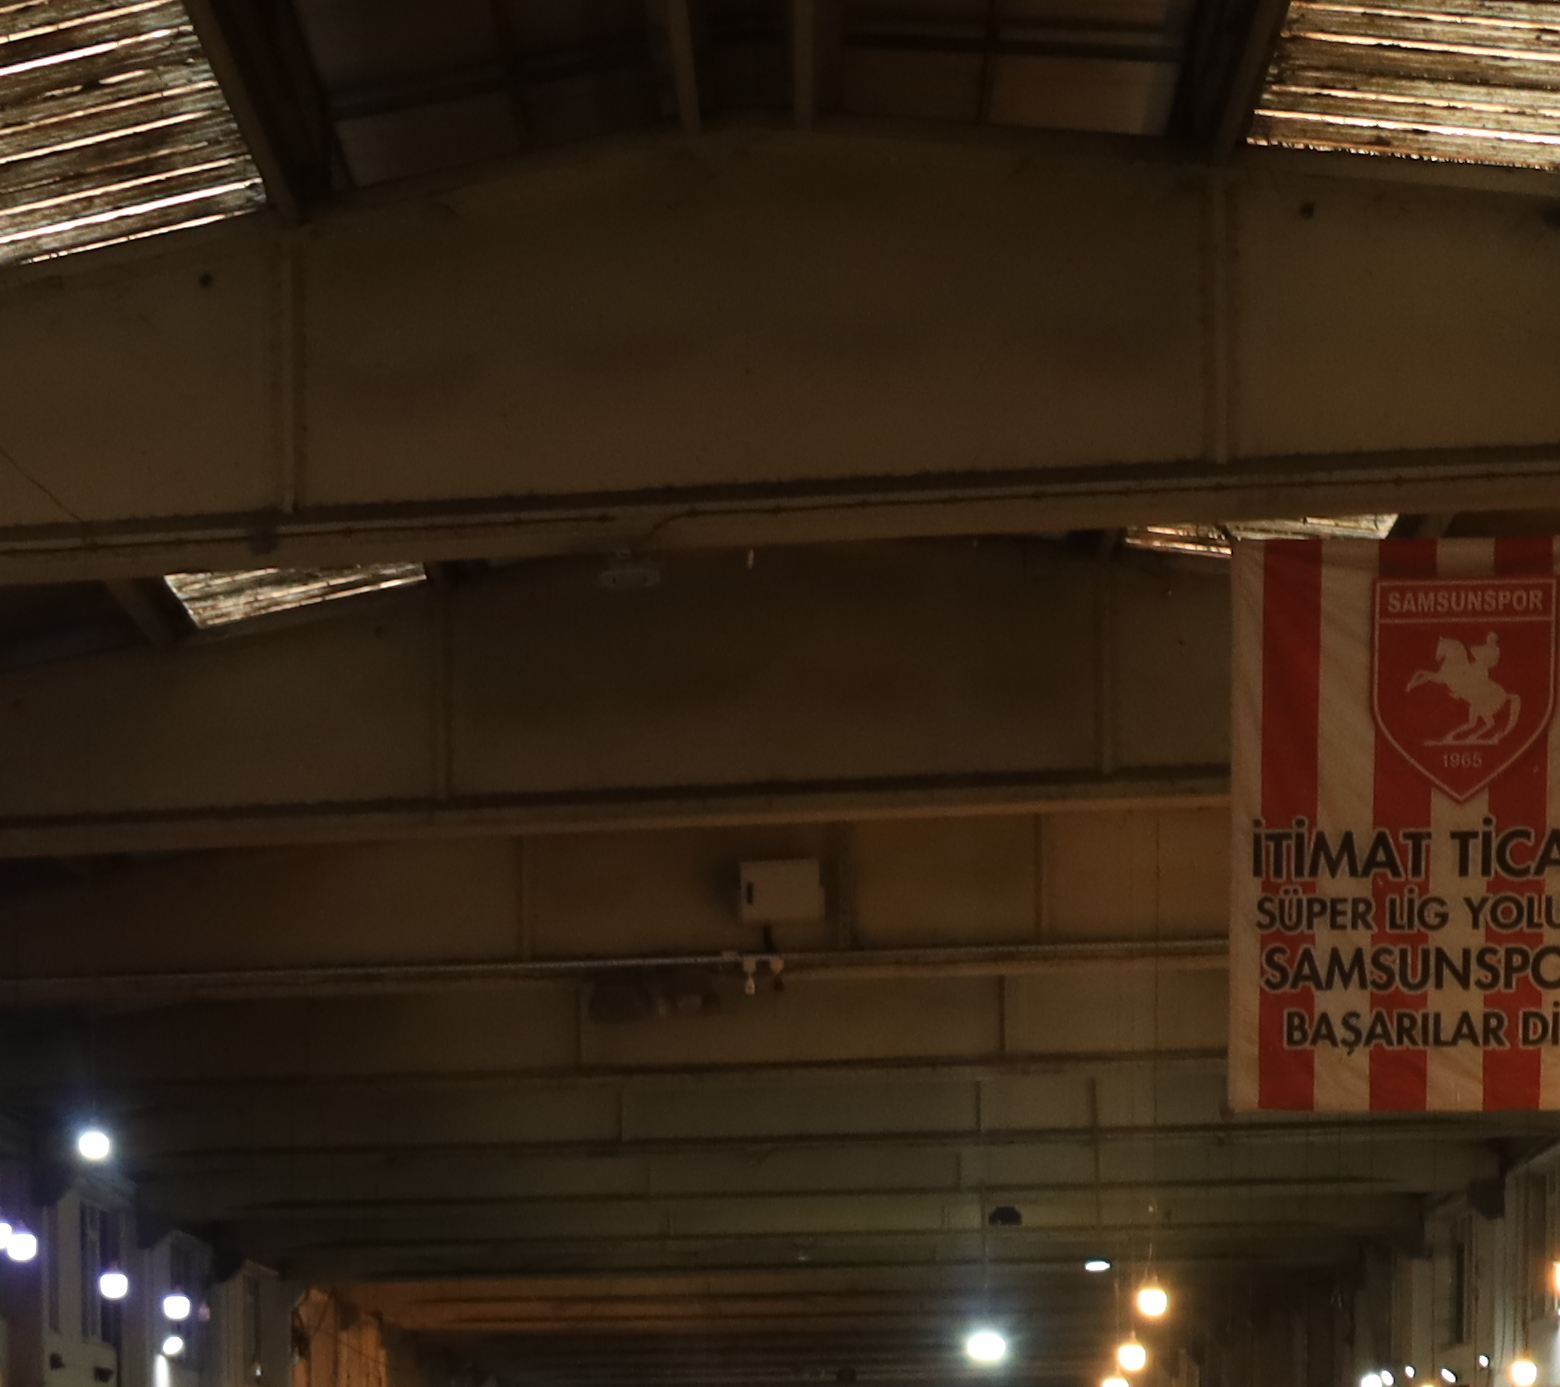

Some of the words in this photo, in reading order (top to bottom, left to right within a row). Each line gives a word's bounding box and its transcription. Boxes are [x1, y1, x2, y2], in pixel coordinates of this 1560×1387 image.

[1387, 589, 1544, 613] SAMSUNSPOR
[1441, 752, 1482, 769] 1965
[1252, 817, 1432, 880] İTİMAT
[1256, 888, 1374, 933] SÜPER
[1388, 885, 1449, 931] LİG
[1286, 1010, 1508, 1055] BAŞARILAR
